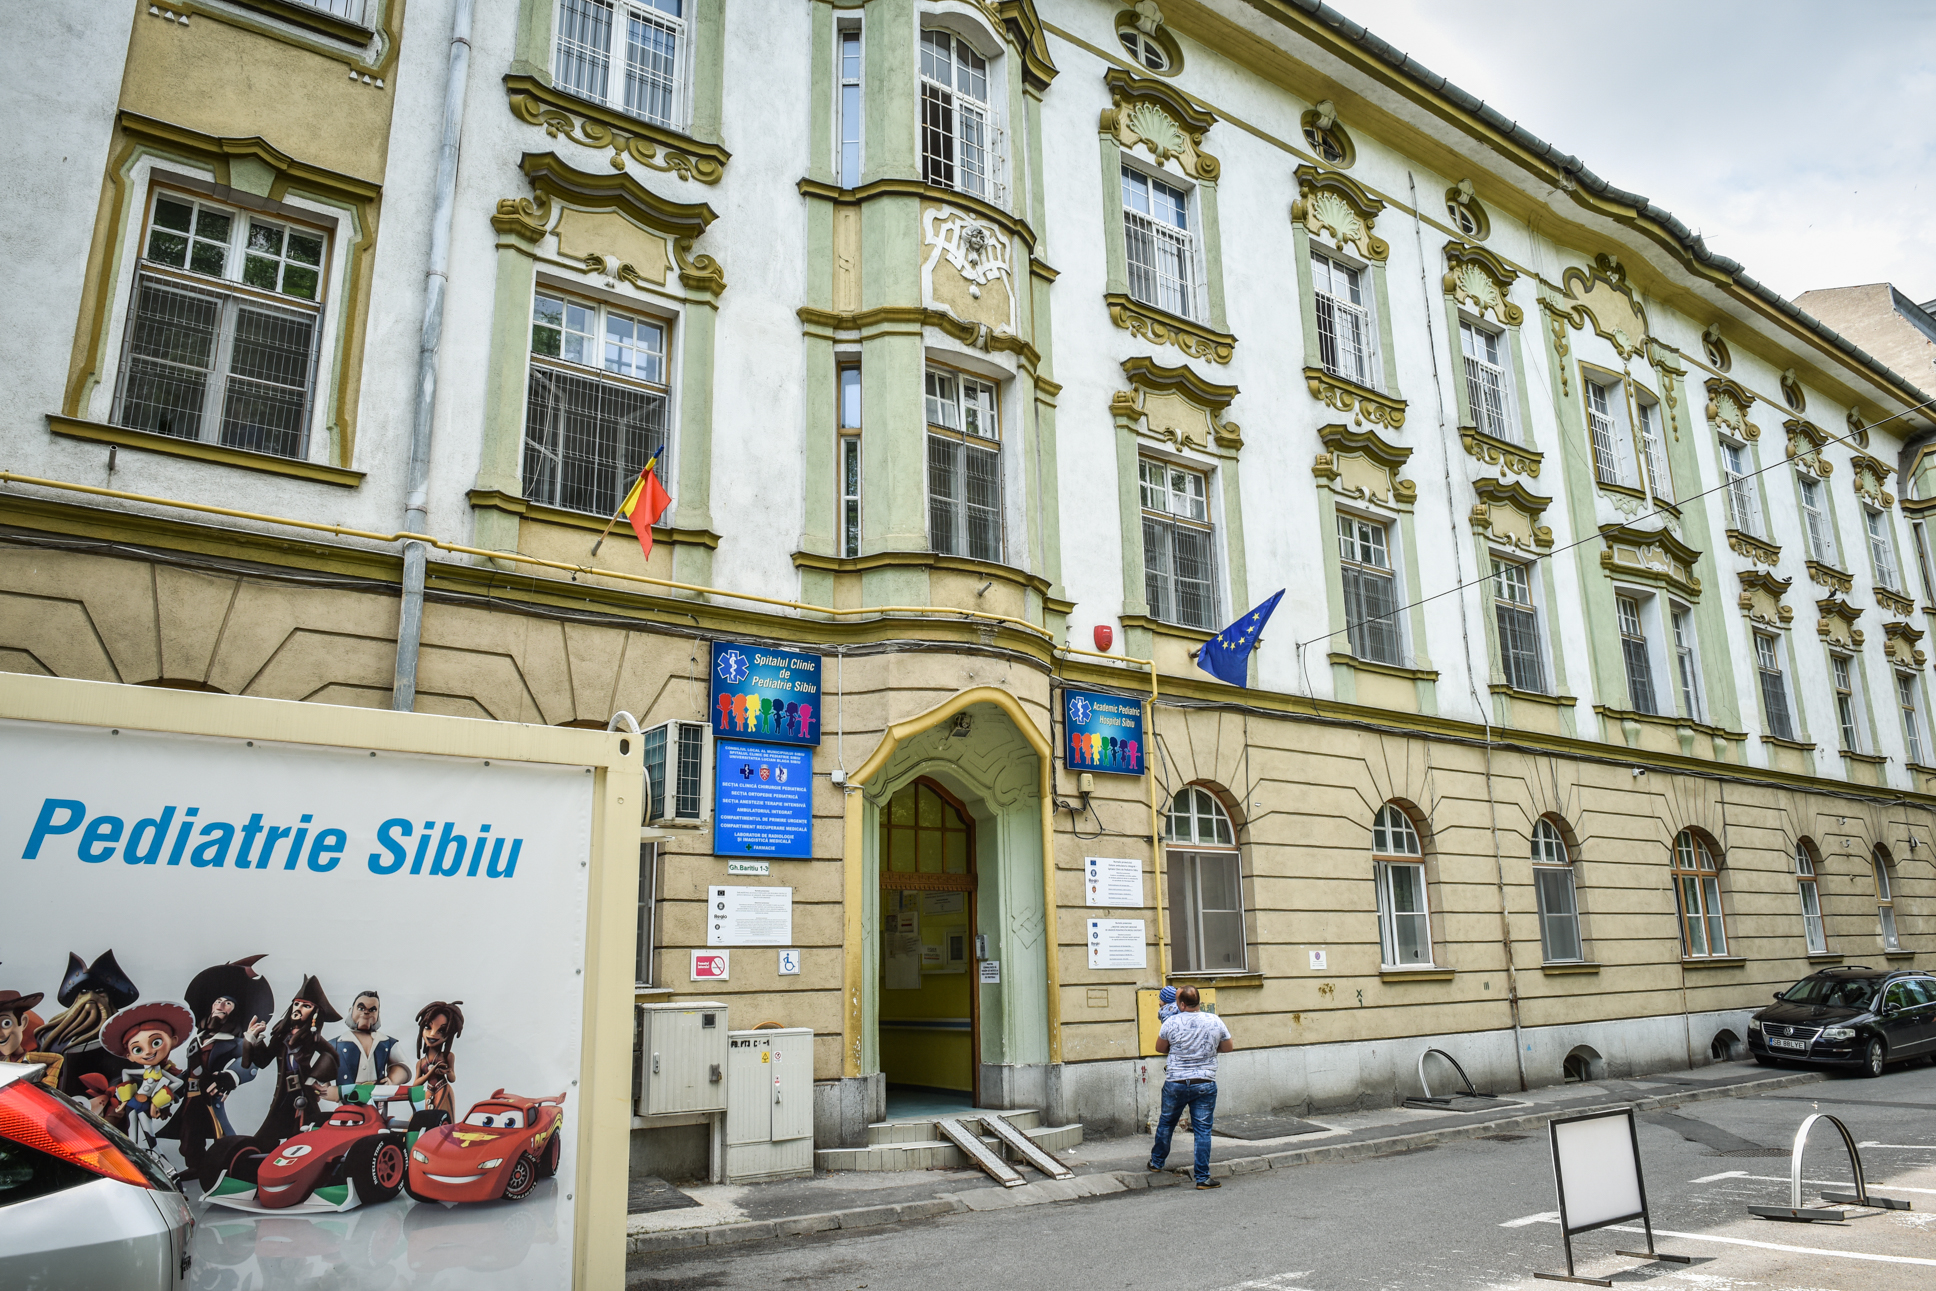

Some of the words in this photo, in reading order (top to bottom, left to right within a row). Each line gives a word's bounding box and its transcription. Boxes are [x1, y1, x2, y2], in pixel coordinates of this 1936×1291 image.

[754, 654, 788, 668] Spitalul
[790, 658, 815, 671] Clinic
[780, 669, 790, 679] de
[752, 676, 792, 690] Pediatrie
[794, 682, 816, 694] Sibiu
[1093, 702, 1118, 713] Academic
[1118, 705, 1140, 716] Pediatric
[1100, 715, 1121, 727] Hospital
[1122, 718, 1135, 728] Sibiu
[21, 798, 348, 873] Pediatrie
[367, 818, 524, 879] Sibiu
[1783, 1040, 1803, 1049] 88LYE
[290, 1146, 304, 1156] 1
[374, 1141, 384, 1156] TIRES
